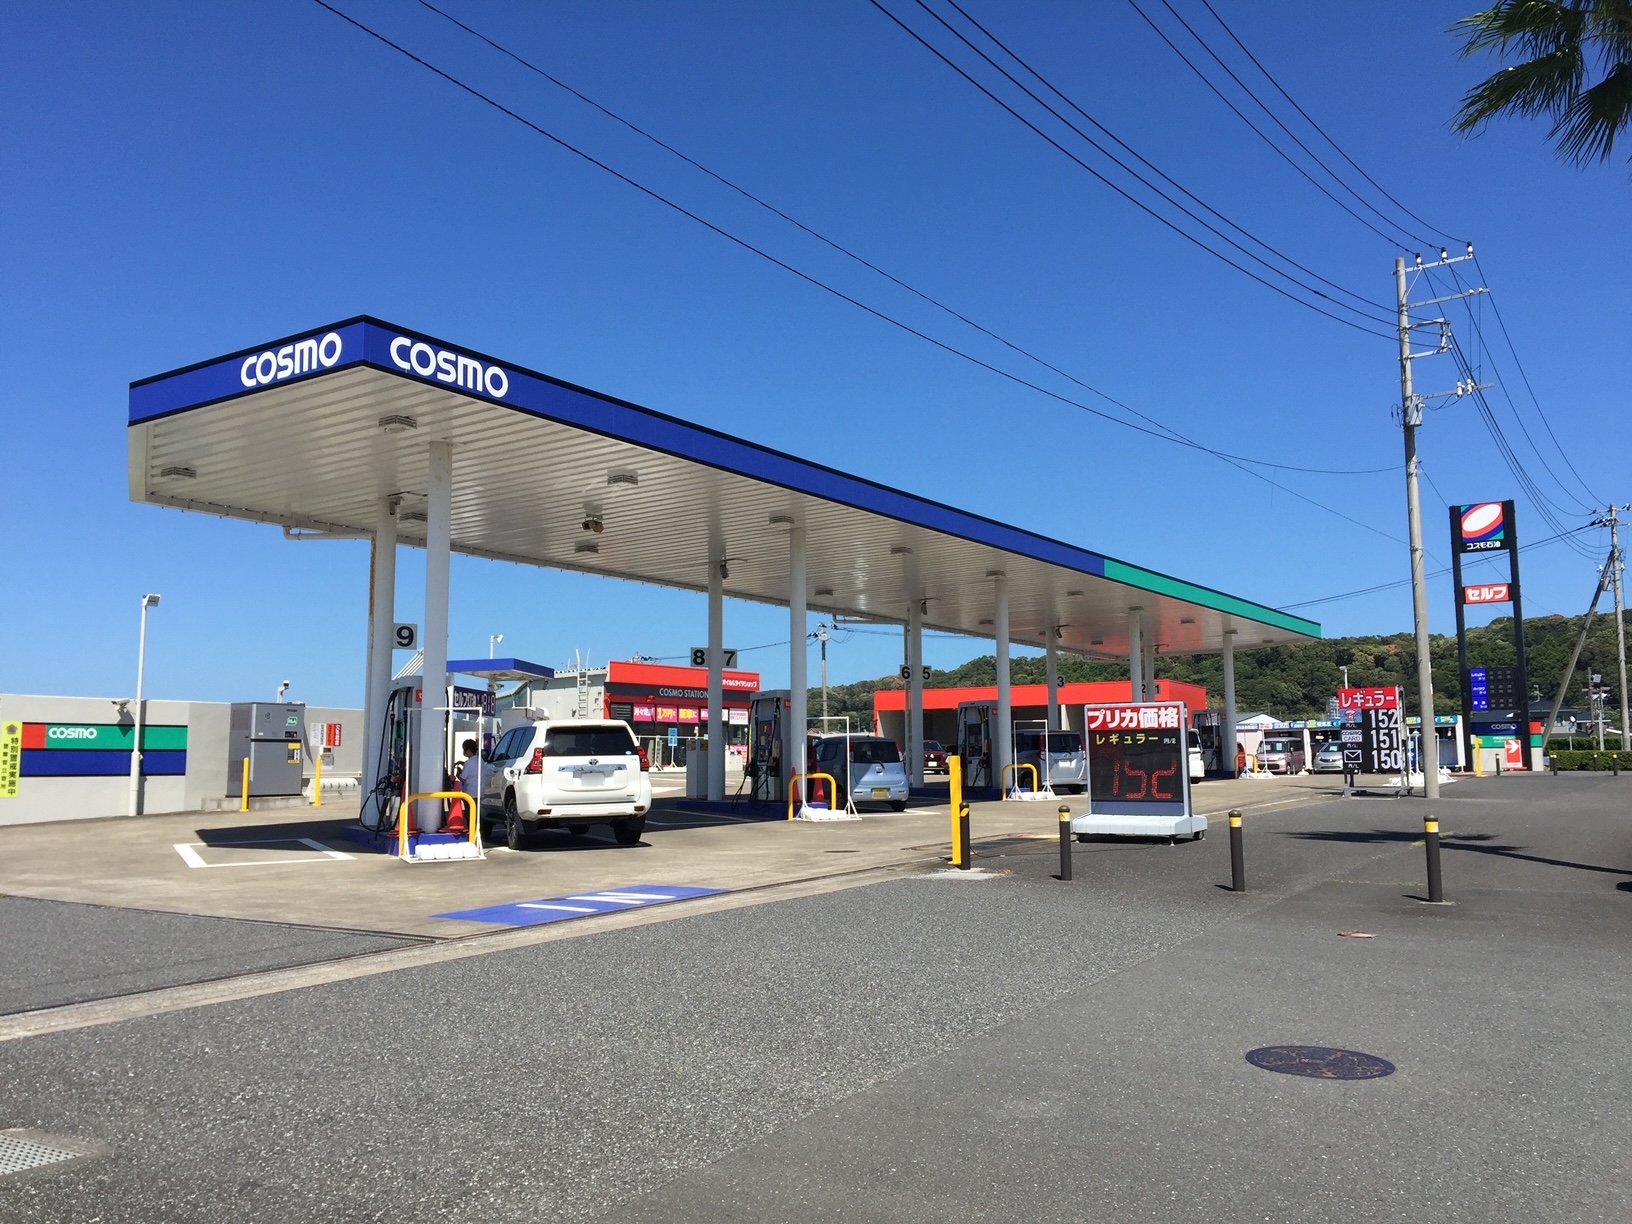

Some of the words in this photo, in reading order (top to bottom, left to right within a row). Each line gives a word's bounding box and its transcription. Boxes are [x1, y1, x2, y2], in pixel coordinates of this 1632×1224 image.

[240, 332, 342, 387] COSMO
[390, 336, 509, 398] COSMO
[1466, 541, 1501, 550] コスモ石油
[1466, 586, 1507, 600] セルフ
[396, 626, 414, 647] 9
[692, 649, 705, 666] 8
[723, 650, 736, 667] 7
[901, 666, 911, 679] 6
[922, 667, 931, 680] 5
[1057, 676, 1065, 688] 3
[659, 687, 683, 697] COSMO
[684, 689, 709, 699] STATION
[1341, 690, 1395, 708] レギュラー
[1087, 707, 1179, 729] プリカ価格
[1369, 708, 1400, 728] 152
[48, 727, 98, 739] COSMO
[1095, 733, 1159, 745] レギュラー
[1370, 729, 1398, 748] 151
[1371, 749, 1402, 769] 150
[1112, 759, 1178, 799] 152
